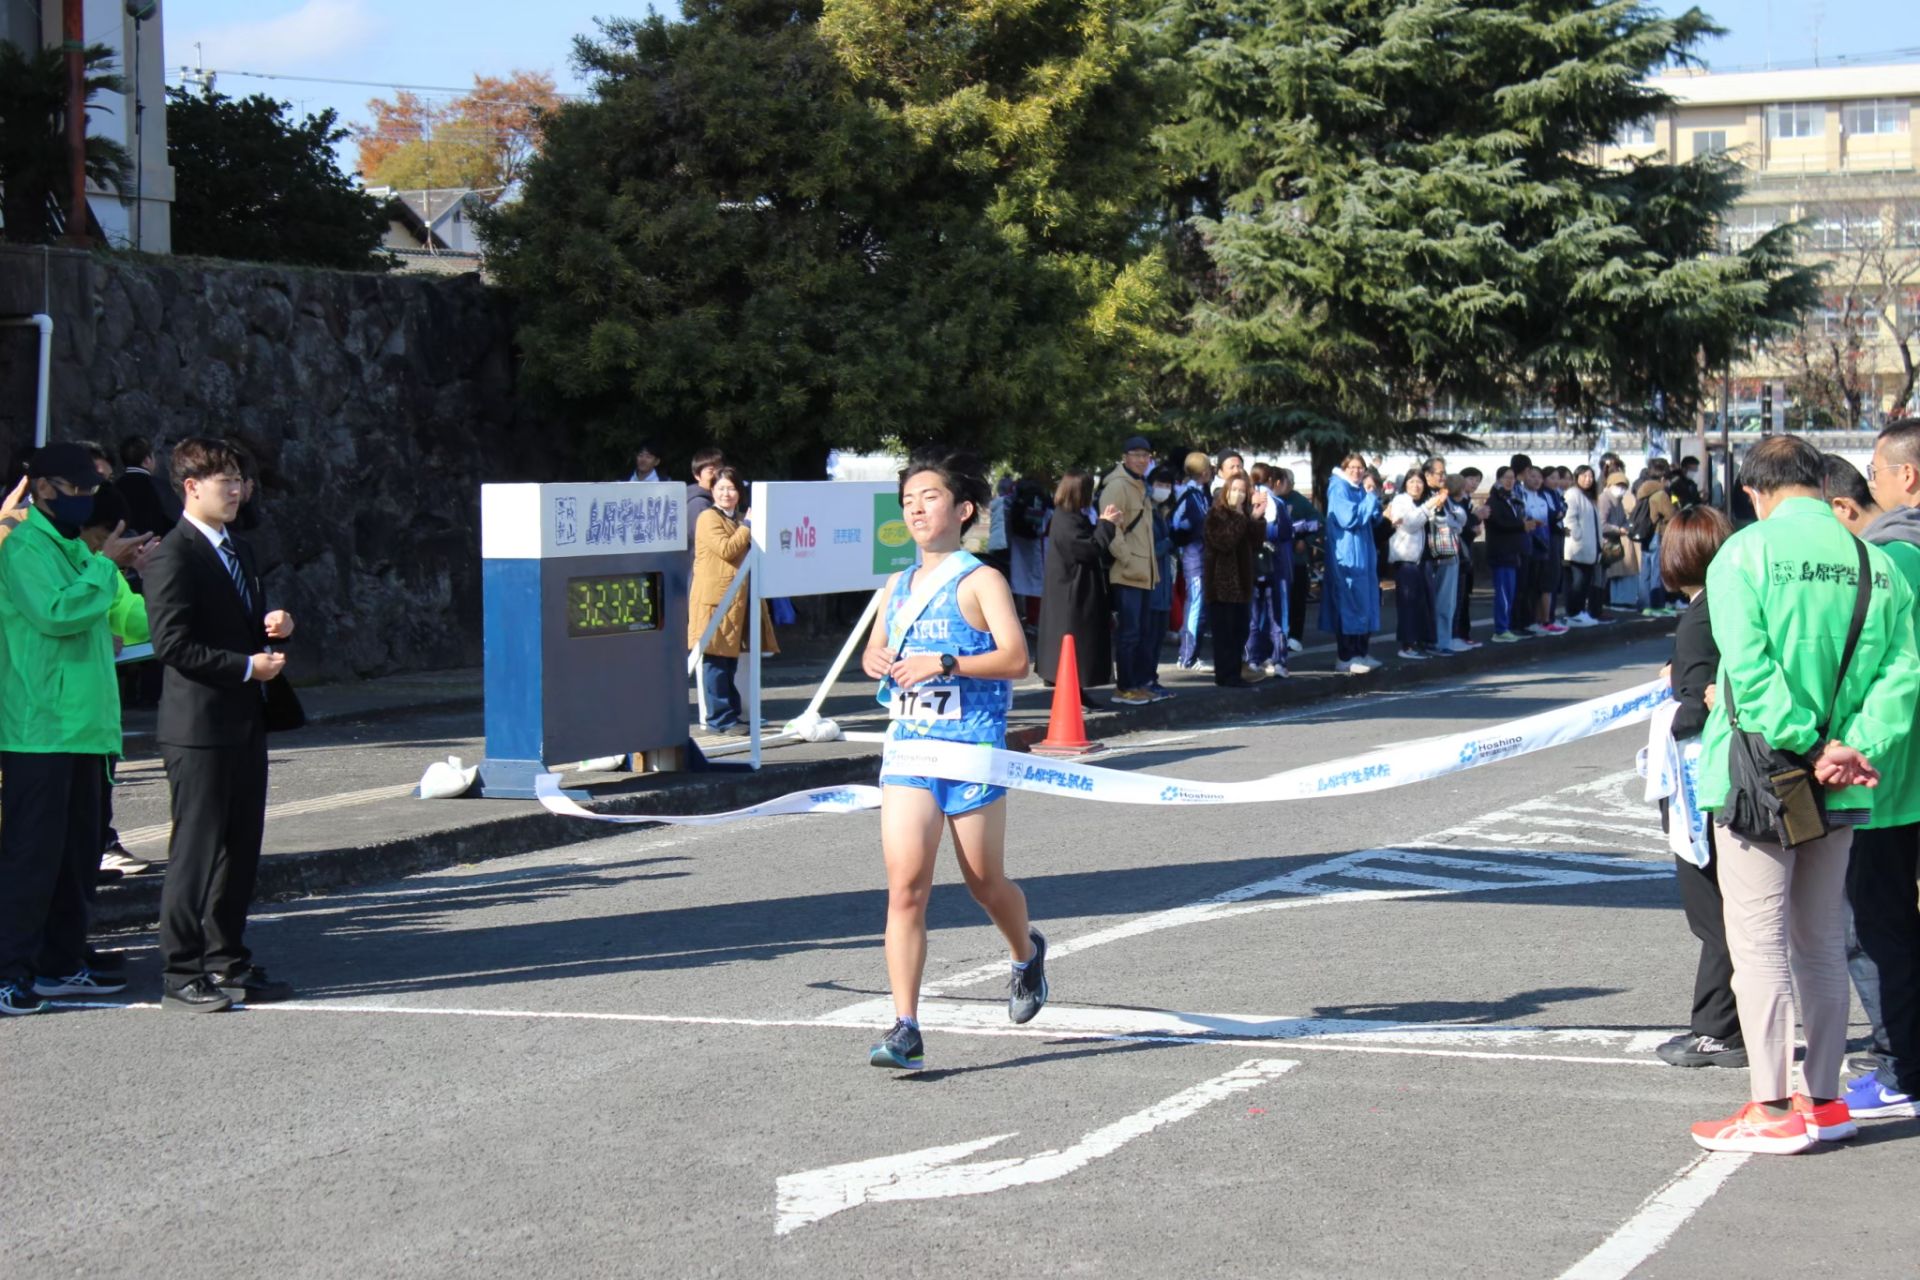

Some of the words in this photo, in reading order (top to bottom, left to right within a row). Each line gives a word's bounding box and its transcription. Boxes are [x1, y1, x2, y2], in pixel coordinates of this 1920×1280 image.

[586, 495, 678, 544] 島原学生駅伝
[899, 691, 952, 716] 17-7
[1479, 736, 1523, 752] Hoshino
